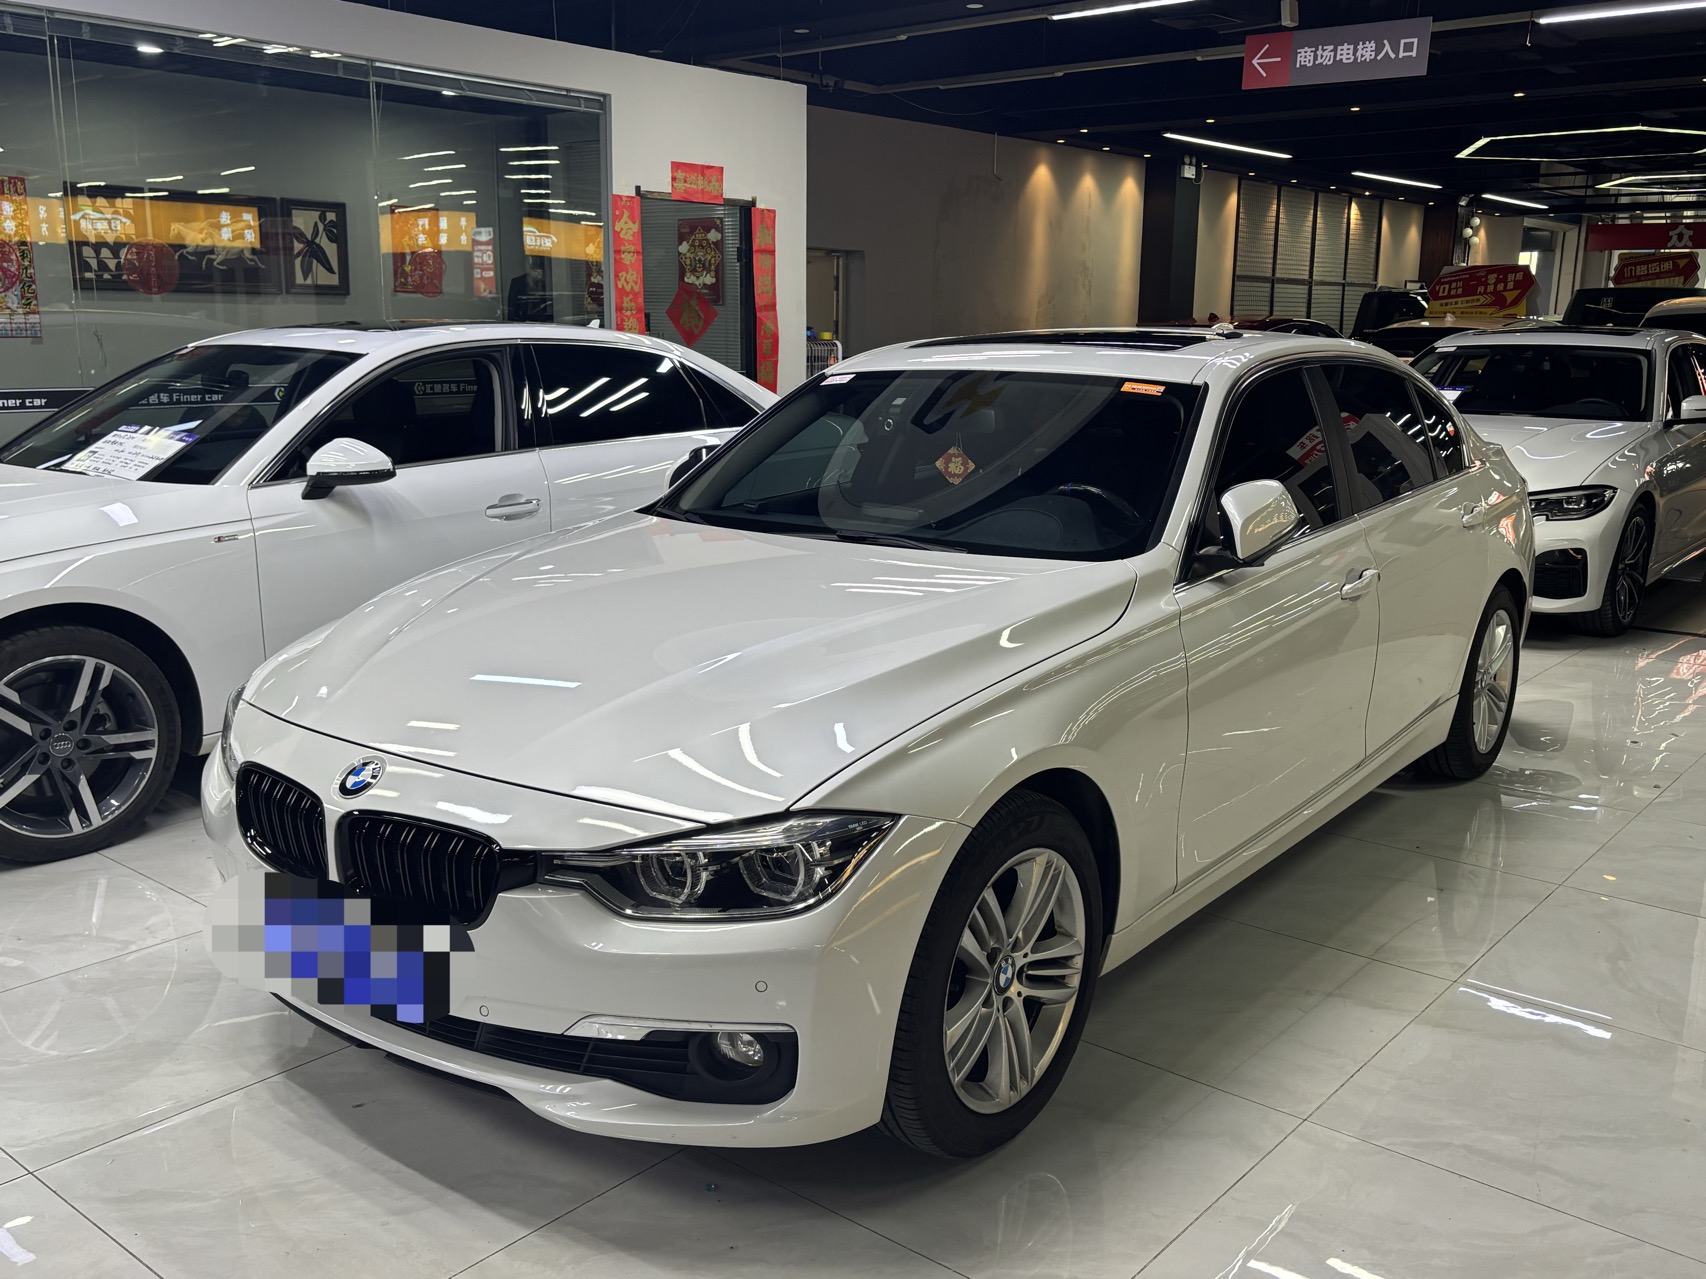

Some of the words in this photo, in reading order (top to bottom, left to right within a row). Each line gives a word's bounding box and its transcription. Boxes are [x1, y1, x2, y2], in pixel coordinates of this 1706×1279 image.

[1296, 37, 1419, 68] 商场电梯入口
[672, 169, 722, 196] 喜迎新春
[1666, 224, 1694, 248] 众
[1623, 260, 1674, 278] 价格透明
[678, 291, 706, 335] 福
[25, 398, 48, 406] car
[172, 392, 202, 403] Finer
[204, 393, 224, 401] car
[948, 457, 965, 474] 福
